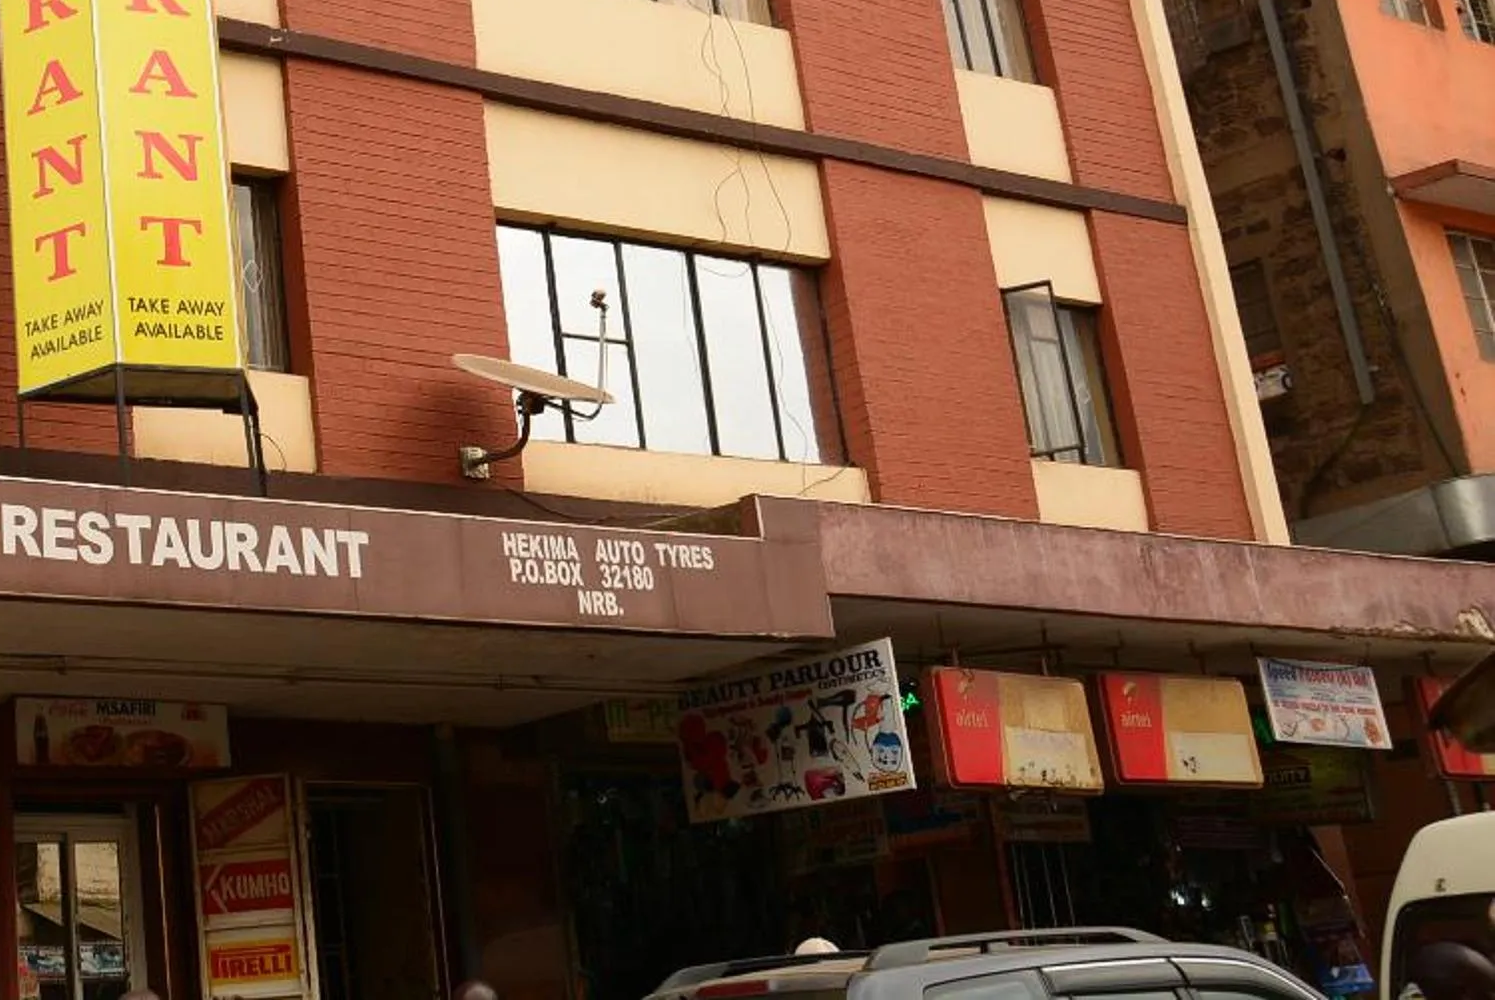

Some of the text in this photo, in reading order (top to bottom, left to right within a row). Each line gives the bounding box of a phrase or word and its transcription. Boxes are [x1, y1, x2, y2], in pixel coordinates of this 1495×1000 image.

[24, 299, 105, 338] TAKE AWAY
[128, 296, 226, 317] TAKE AWAY
[30, 324, 104, 360] AVAILABLE
[134, 321, 224, 341] AVAILABLE
[1, 502, 370, 580] RESTAURANT
[502, 532, 715, 570] HEKIMA AUTO TYRES
[599, 564, 654, 591] 32180
[577, 589, 625, 617] NRB.
[677, 675, 764, 710] BEAUTY
[769, 648, 884, 693] PARLOUR
[95, 700, 157, 717] MSAFIRI
[956, 709, 991, 729] airtel
[1119, 710, 1153, 729] airtel
[218, 871, 291, 901] KUMHO
